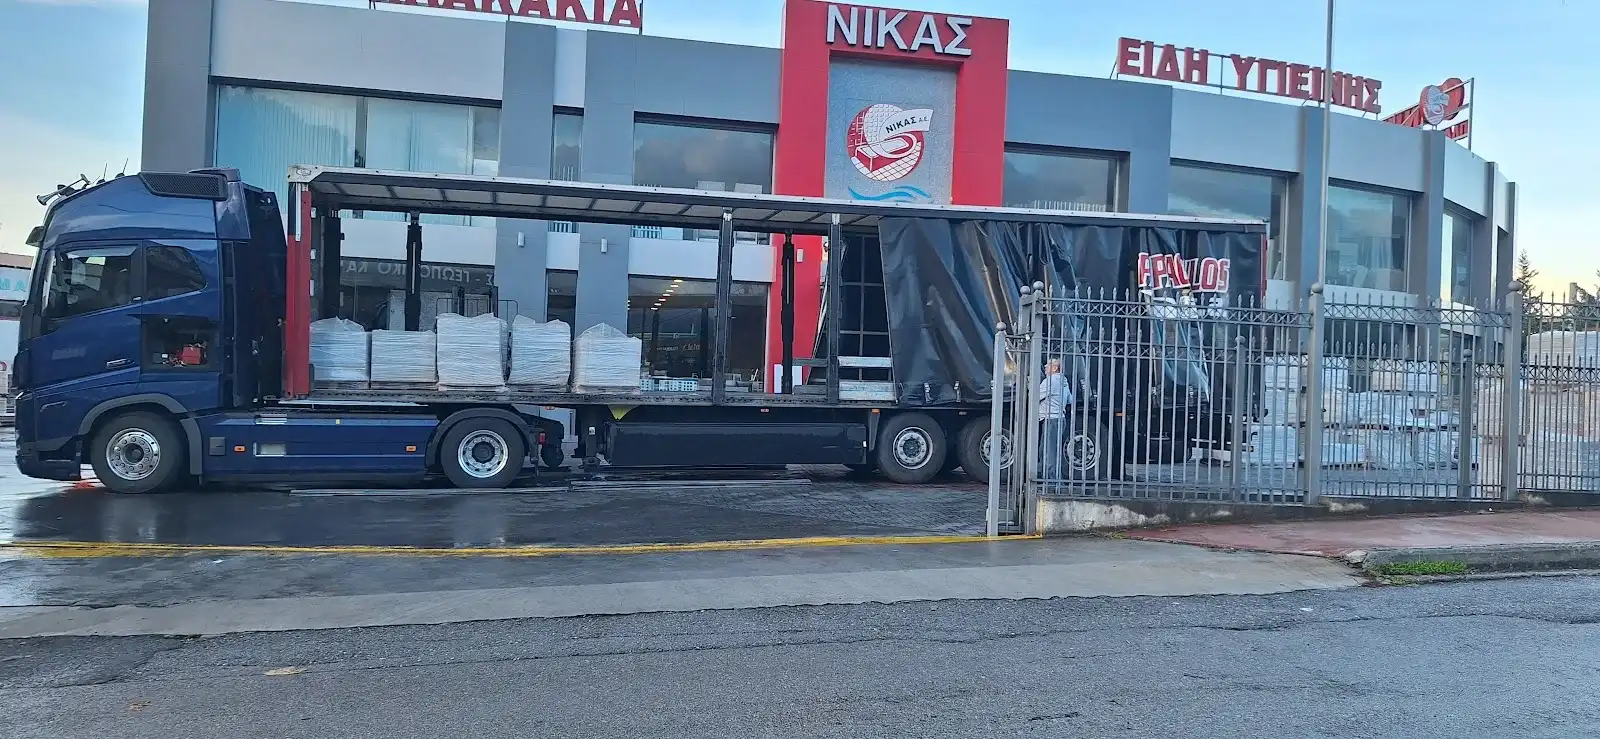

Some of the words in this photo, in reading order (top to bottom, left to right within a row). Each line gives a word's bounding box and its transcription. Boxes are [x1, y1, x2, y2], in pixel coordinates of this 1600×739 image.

[826, 4, 973, 56] ΝΙΚΑΣ
[1117, 36, 1209, 86] ΕΙΔΗ
[1230, 53, 1382, 114] ΥΓΙΕΙΝΗΣ
[885, 116, 917, 134] ΝΙΚΑΣ
